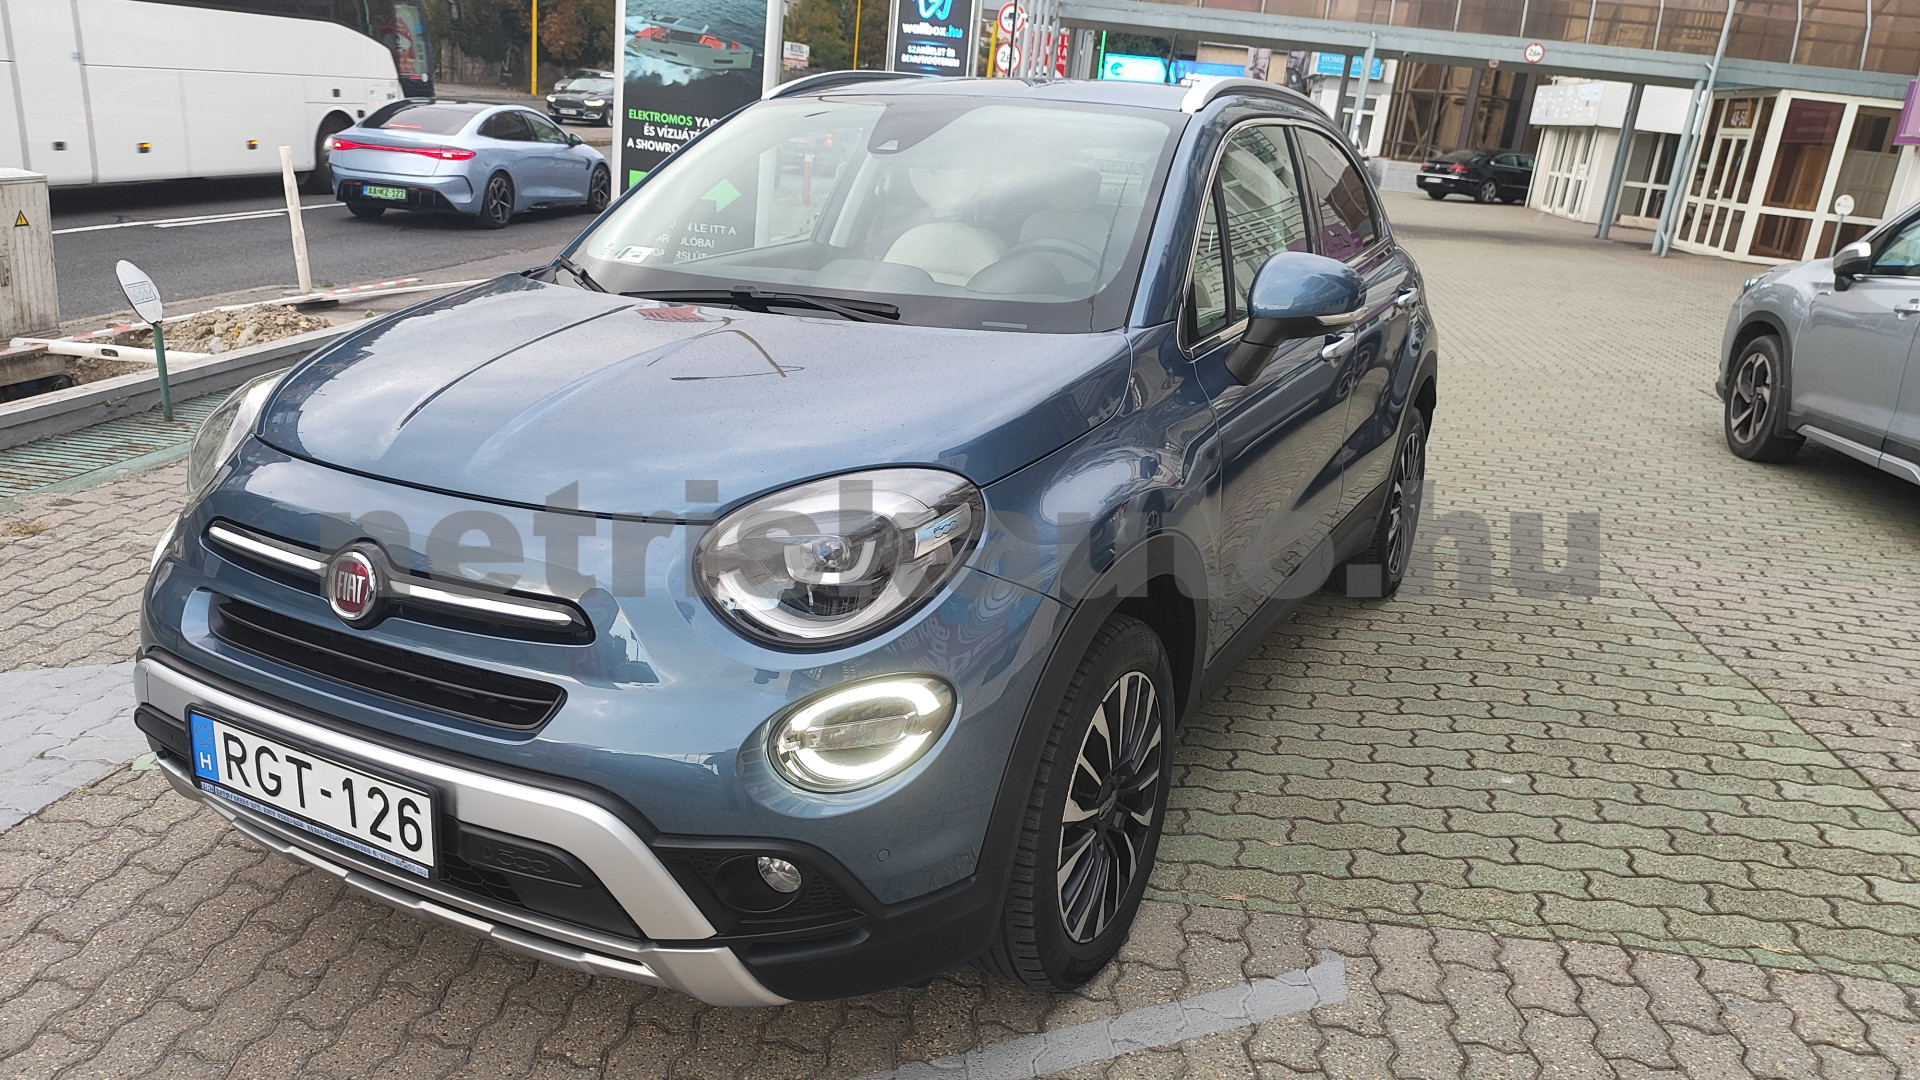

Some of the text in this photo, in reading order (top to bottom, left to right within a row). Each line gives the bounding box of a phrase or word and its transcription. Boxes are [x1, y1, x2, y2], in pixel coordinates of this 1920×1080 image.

[902, 22, 963, 38] wallbox.hu
[628, 108, 693, 126] ELEKTROMOS
[643, 122, 655, 137] ÉS
[627, 138, 634, 148] A
[337, 570, 366, 604] FIAT
[200, 752, 212, 771] H
[222, 731, 423, 852] RGT-126
